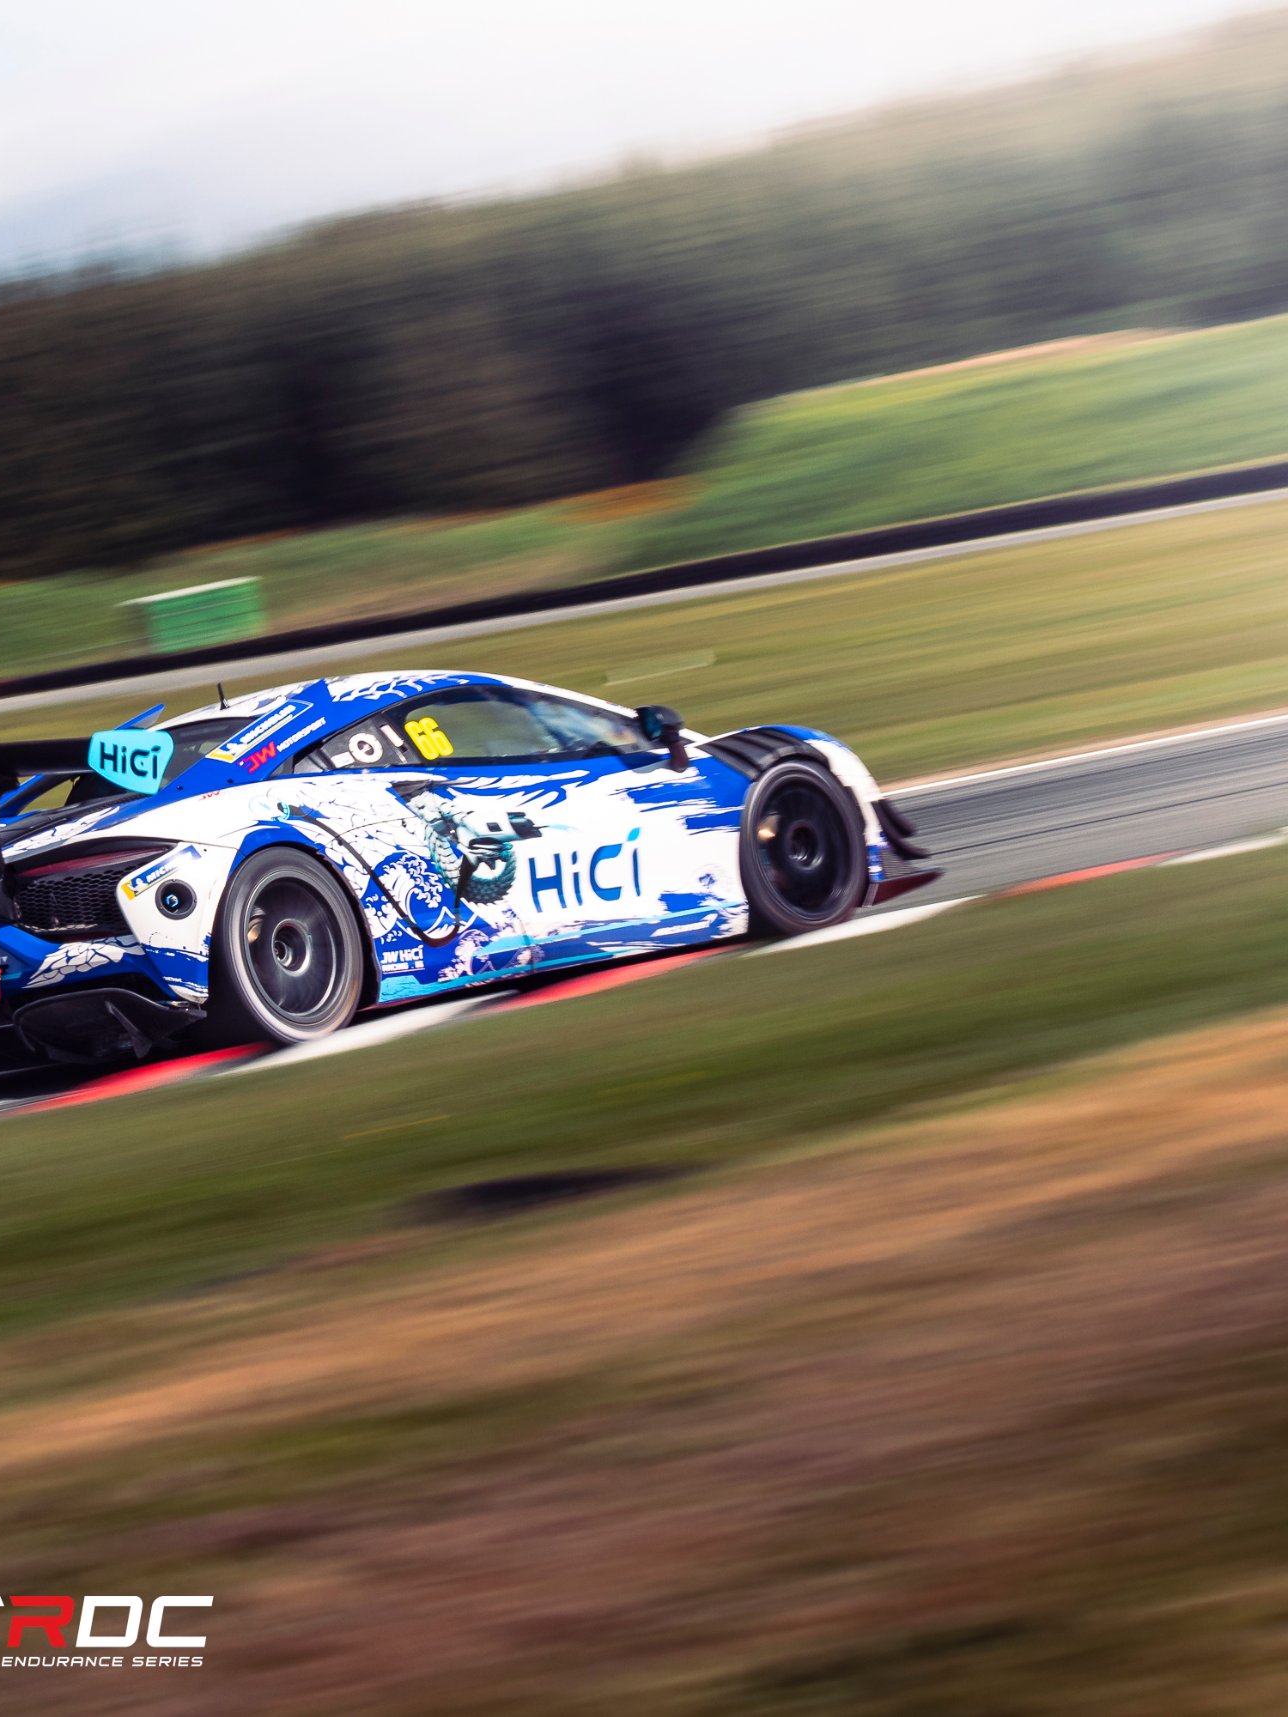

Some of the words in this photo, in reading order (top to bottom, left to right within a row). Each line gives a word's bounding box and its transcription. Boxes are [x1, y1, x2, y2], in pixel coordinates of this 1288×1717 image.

[276, 716, 326, 752] MOTORSPORT
[404, 717, 454, 760] 66
[380, 952, 400, 964] JW
